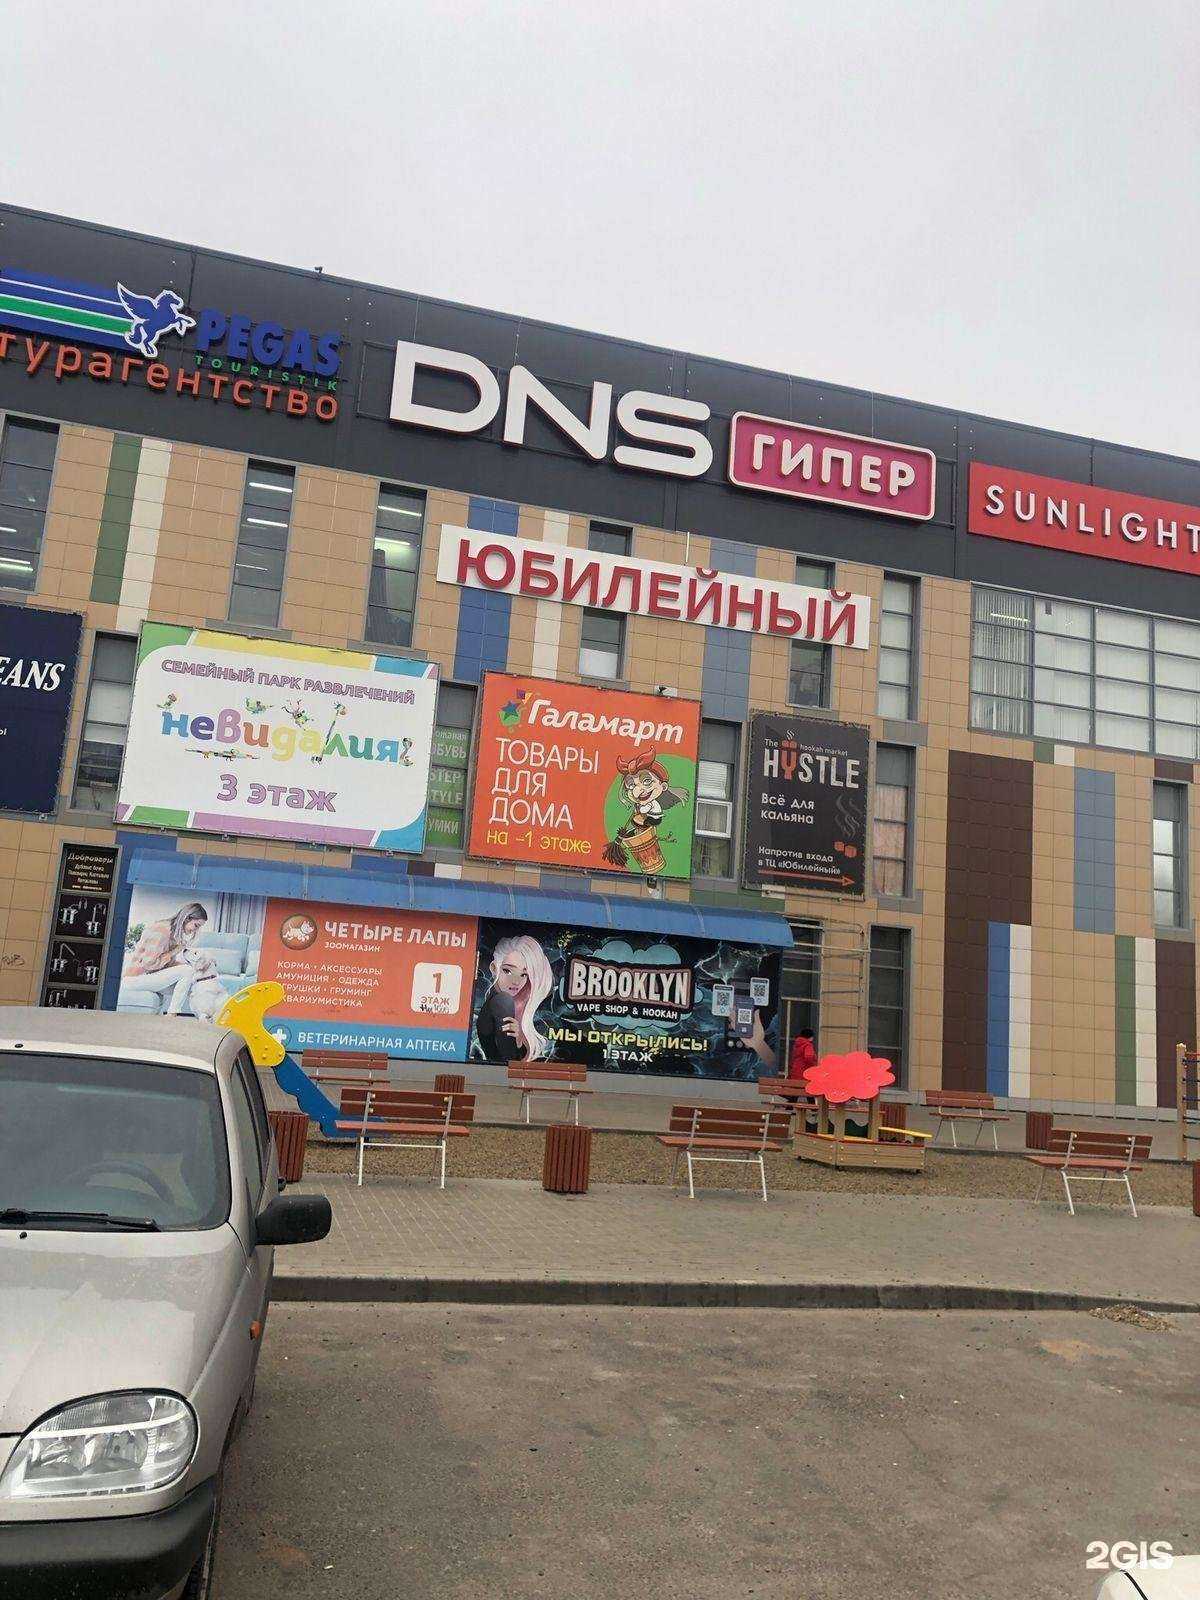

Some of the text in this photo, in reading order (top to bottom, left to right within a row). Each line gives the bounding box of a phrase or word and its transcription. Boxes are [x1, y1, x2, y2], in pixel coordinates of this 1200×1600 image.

[200, 307, 343, 376] PEGAS
[195, 354, 338, 391] TOURISTIK
[389, 340, 714, 477] DNS
[751, 433, 916, 496] ГИПЕР
[985, 484, 1200, 553] SUNLIGHT
[457, 538, 856, 645] ЮБИЛЕЙНЫЙ
[161, 659, 416, 705] СЕМЕЙНЫЙ ПАРК РАЗВЛЕЧЕНИЙ
[528, 698, 684, 747] Галамарт
[434, 729, 467, 740] ожаная
[764, 738, 779, 747] The
[495, 737, 600, 775] ТОВАРЫ
[216, 773, 338, 813] 3 этаж
[491, 767, 547, 798] ДЛЯ
[430, 788, 464, 806] TYLE
[761, 792, 815, 810] Всё для
[488, 797, 574, 830] ДОМА
[760, 809, 814, 825] кальяна
[427, 816, 459, 834] УМКИ
[486, 829, 508, 846] на
[540, 838, 592, 854] этаже
[758, 846, 834, 863] Напротив входа
[765, 859, 777, 868] ТЦ
[324, 921, 467, 948] ЧЕТЫРЕ ЛАПЫ
[324, 941, 381, 952] ЗООМАГАЗИН
[276, 960, 384, 976] КОРМА АКСЕССУАРЫ
[276, 972, 380, 987] АМУНИЦИЯ ОДЕЖДА
[282, 983, 373, 997] ГРУШКИ ГРУМИНГ
[432, 972, 443, 994] 1
[571, 961, 690, 1006] BROOKLYN
[282, 994, 364, 1008] КВАРИУМИСТИКА
[420, 995, 451, 1006] ЭТАЖ
[576, 1003, 678, 1020] VAPE SHOP & HOOKAH
[297, 1031, 457, 1053] ВЕТЕРИНАРНАЯ АПТЕКА
[548, 1027, 709, 1052] МЫ ОТКРЫЛИСЬ!
